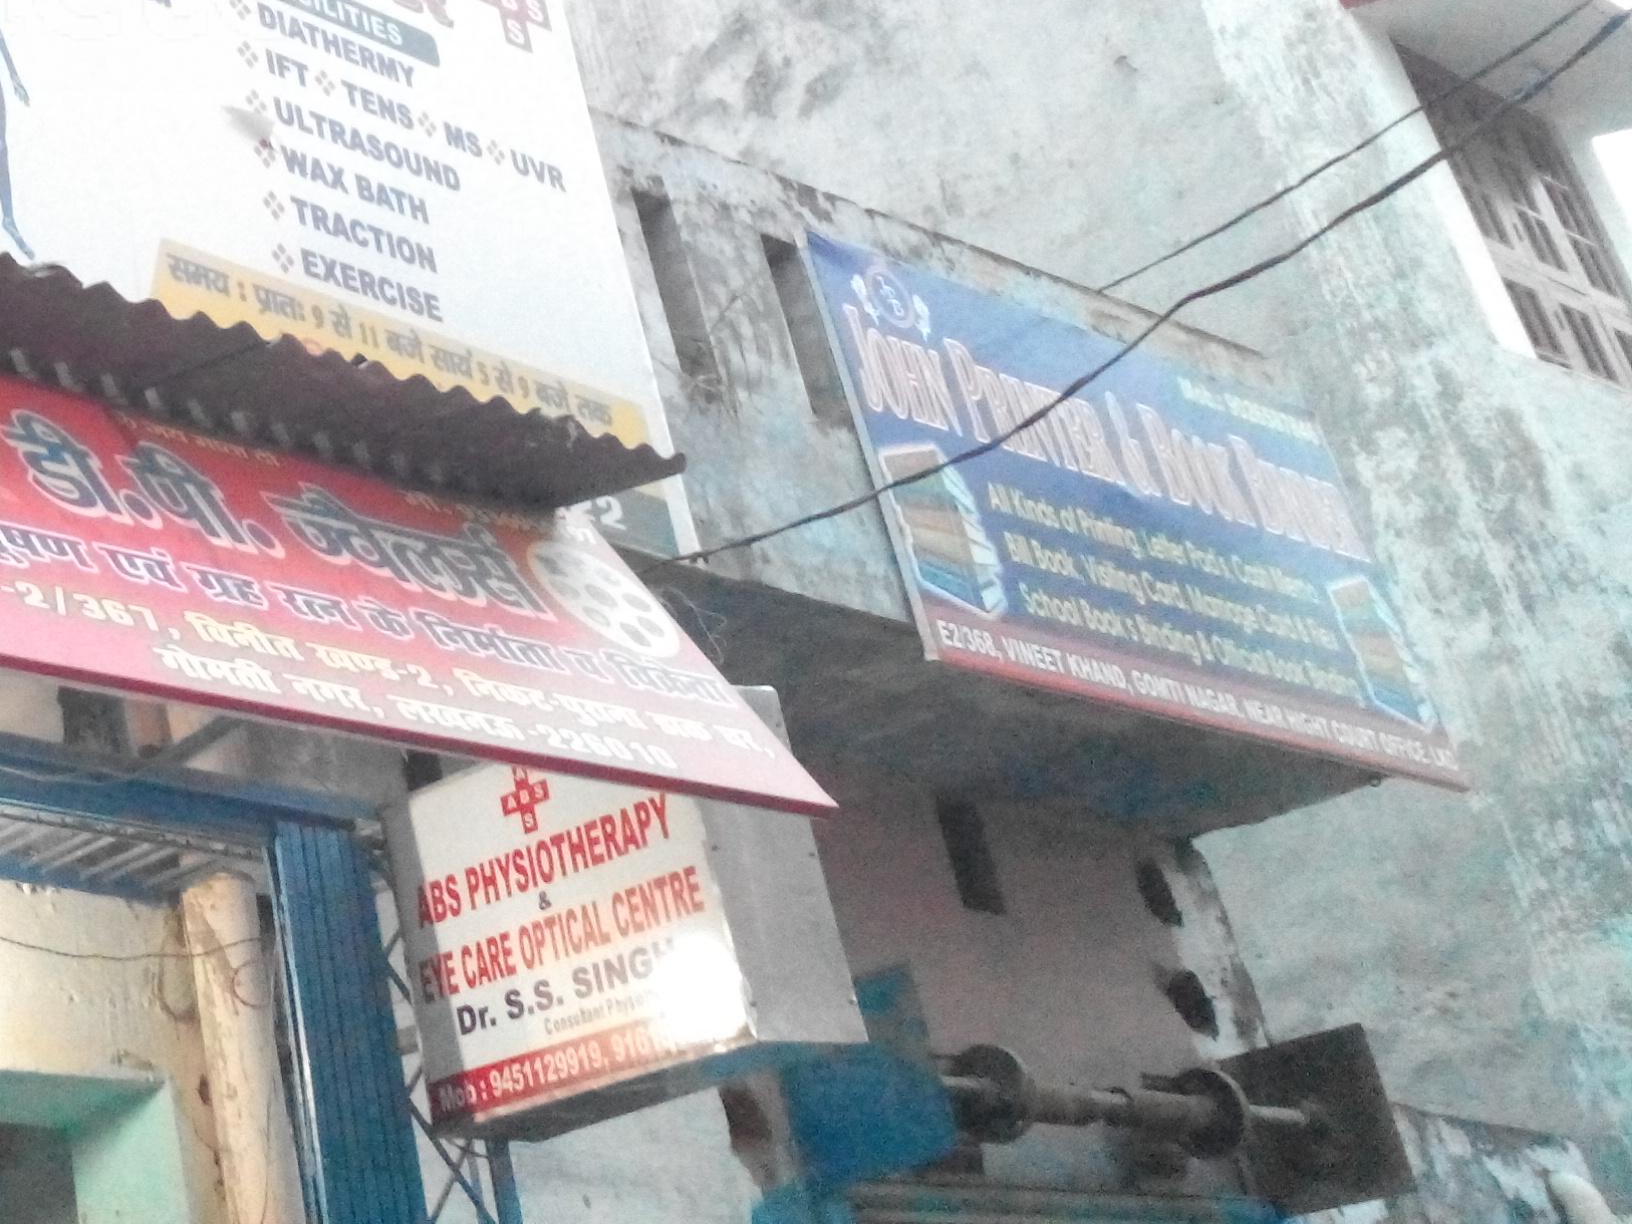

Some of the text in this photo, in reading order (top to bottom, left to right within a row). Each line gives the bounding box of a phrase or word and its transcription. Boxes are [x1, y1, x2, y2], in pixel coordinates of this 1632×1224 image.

[257, 2, 414, 87] DIATHERMY
[265, 49, 566, 192] IFT TENS MS UVR
[273, 97, 461, 192] ULTRASOUND
[280, 145, 429, 224] WAX BATH
[290, 196, 438, 274] TRACTION
[300, 248, 443, 323] EXERCISE
[167, 254, 234, 301] समय
[328, 305, 357, 344] से
[383, 328, 428, 369] बजे
[492, 361, 518, 399] से
[532, 379, 575, 416] बजे
[1103, 390, 1163, 499] &
[987, 482, 1012, 513] All
[1010, 489, 1061, 529] Kinds
[1059, 506, 1079, 533] of
[179, 561, 270, 611] ग्रह
[350, 594, 416, 642] के
[407, 606, 572, 676] निर्माता
[571, 648, 609, 682] व
[184, 610, 305, 661] विनीत
[1018, 581, 1082, 626] School
[152, 643, 288, 697] गोमती
[386, 694, 533, 746] लखनऊ
[1000, 635, 1065, 674] VINEET
[1130, 669, 1185, 704] GOMTI
[1243, 699, 1287, 728] NEAR
[1330, 719, 1375, 751] COURT
[417, 793, 670, 928] ABS PHYSIOTHERAPY
[537, 890, 553, 911] &
[419, 865, 706, 1004] EYE CARE OPTICAL CENTRE
[457, 1005, 497, 1037] Dr.
[504, 979, 564, 1021] S.S.
